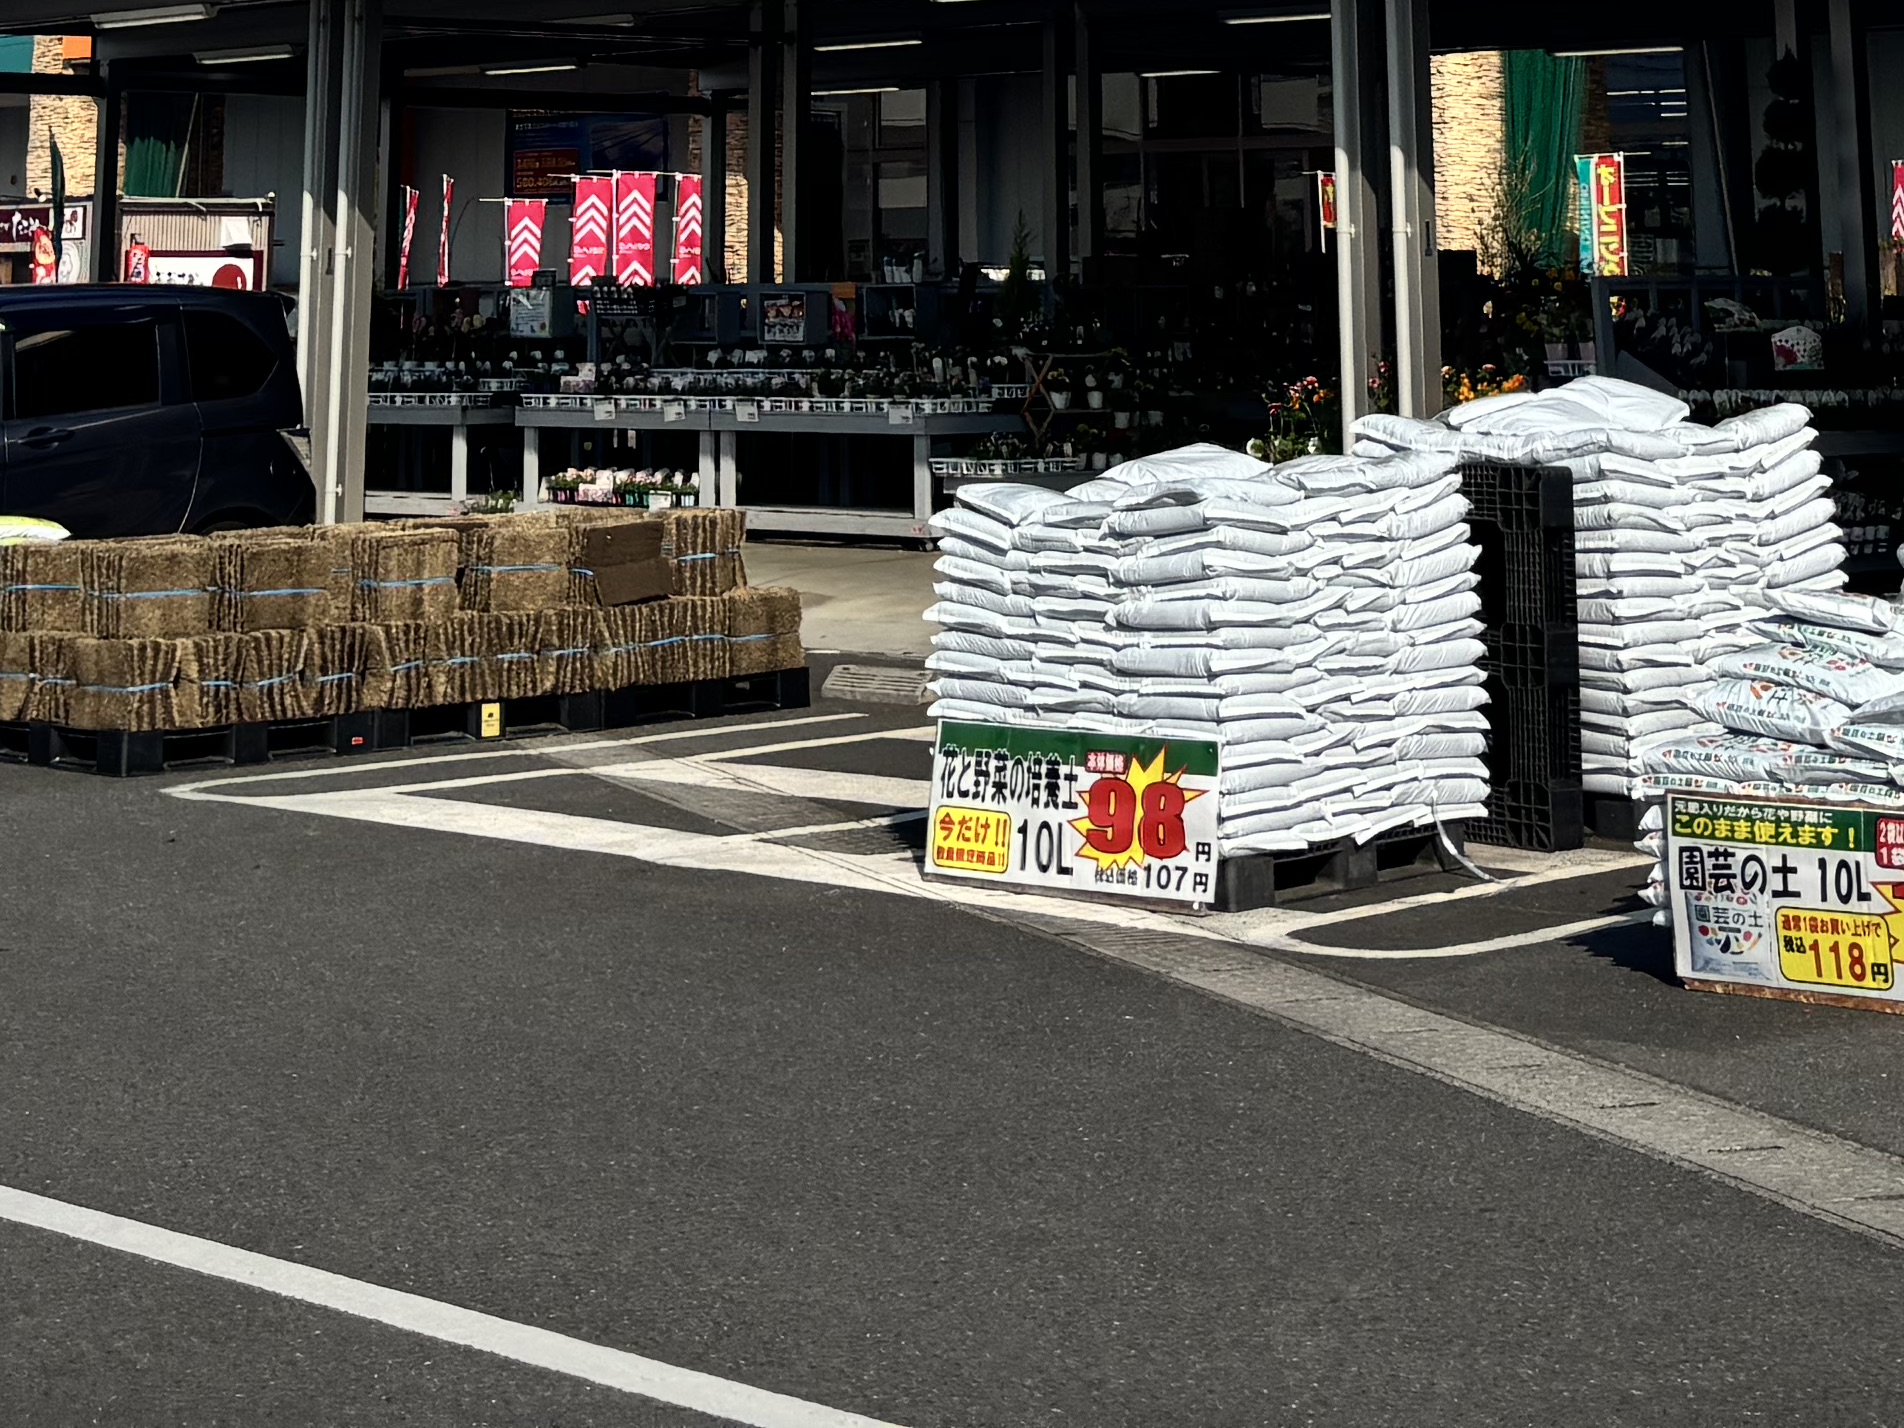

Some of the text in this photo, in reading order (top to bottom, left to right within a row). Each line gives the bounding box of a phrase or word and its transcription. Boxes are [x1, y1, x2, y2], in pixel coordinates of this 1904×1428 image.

[940, 743, 1079, 810] 花と野菜の培養土
[1016, 818, 1074, 877] 10L
[1085, 776, 1212, 863] 98 円
[1678, 845, 1872, 905] 園芸の土 10L
[1694, 903, 1764, 929] 園芸の土
